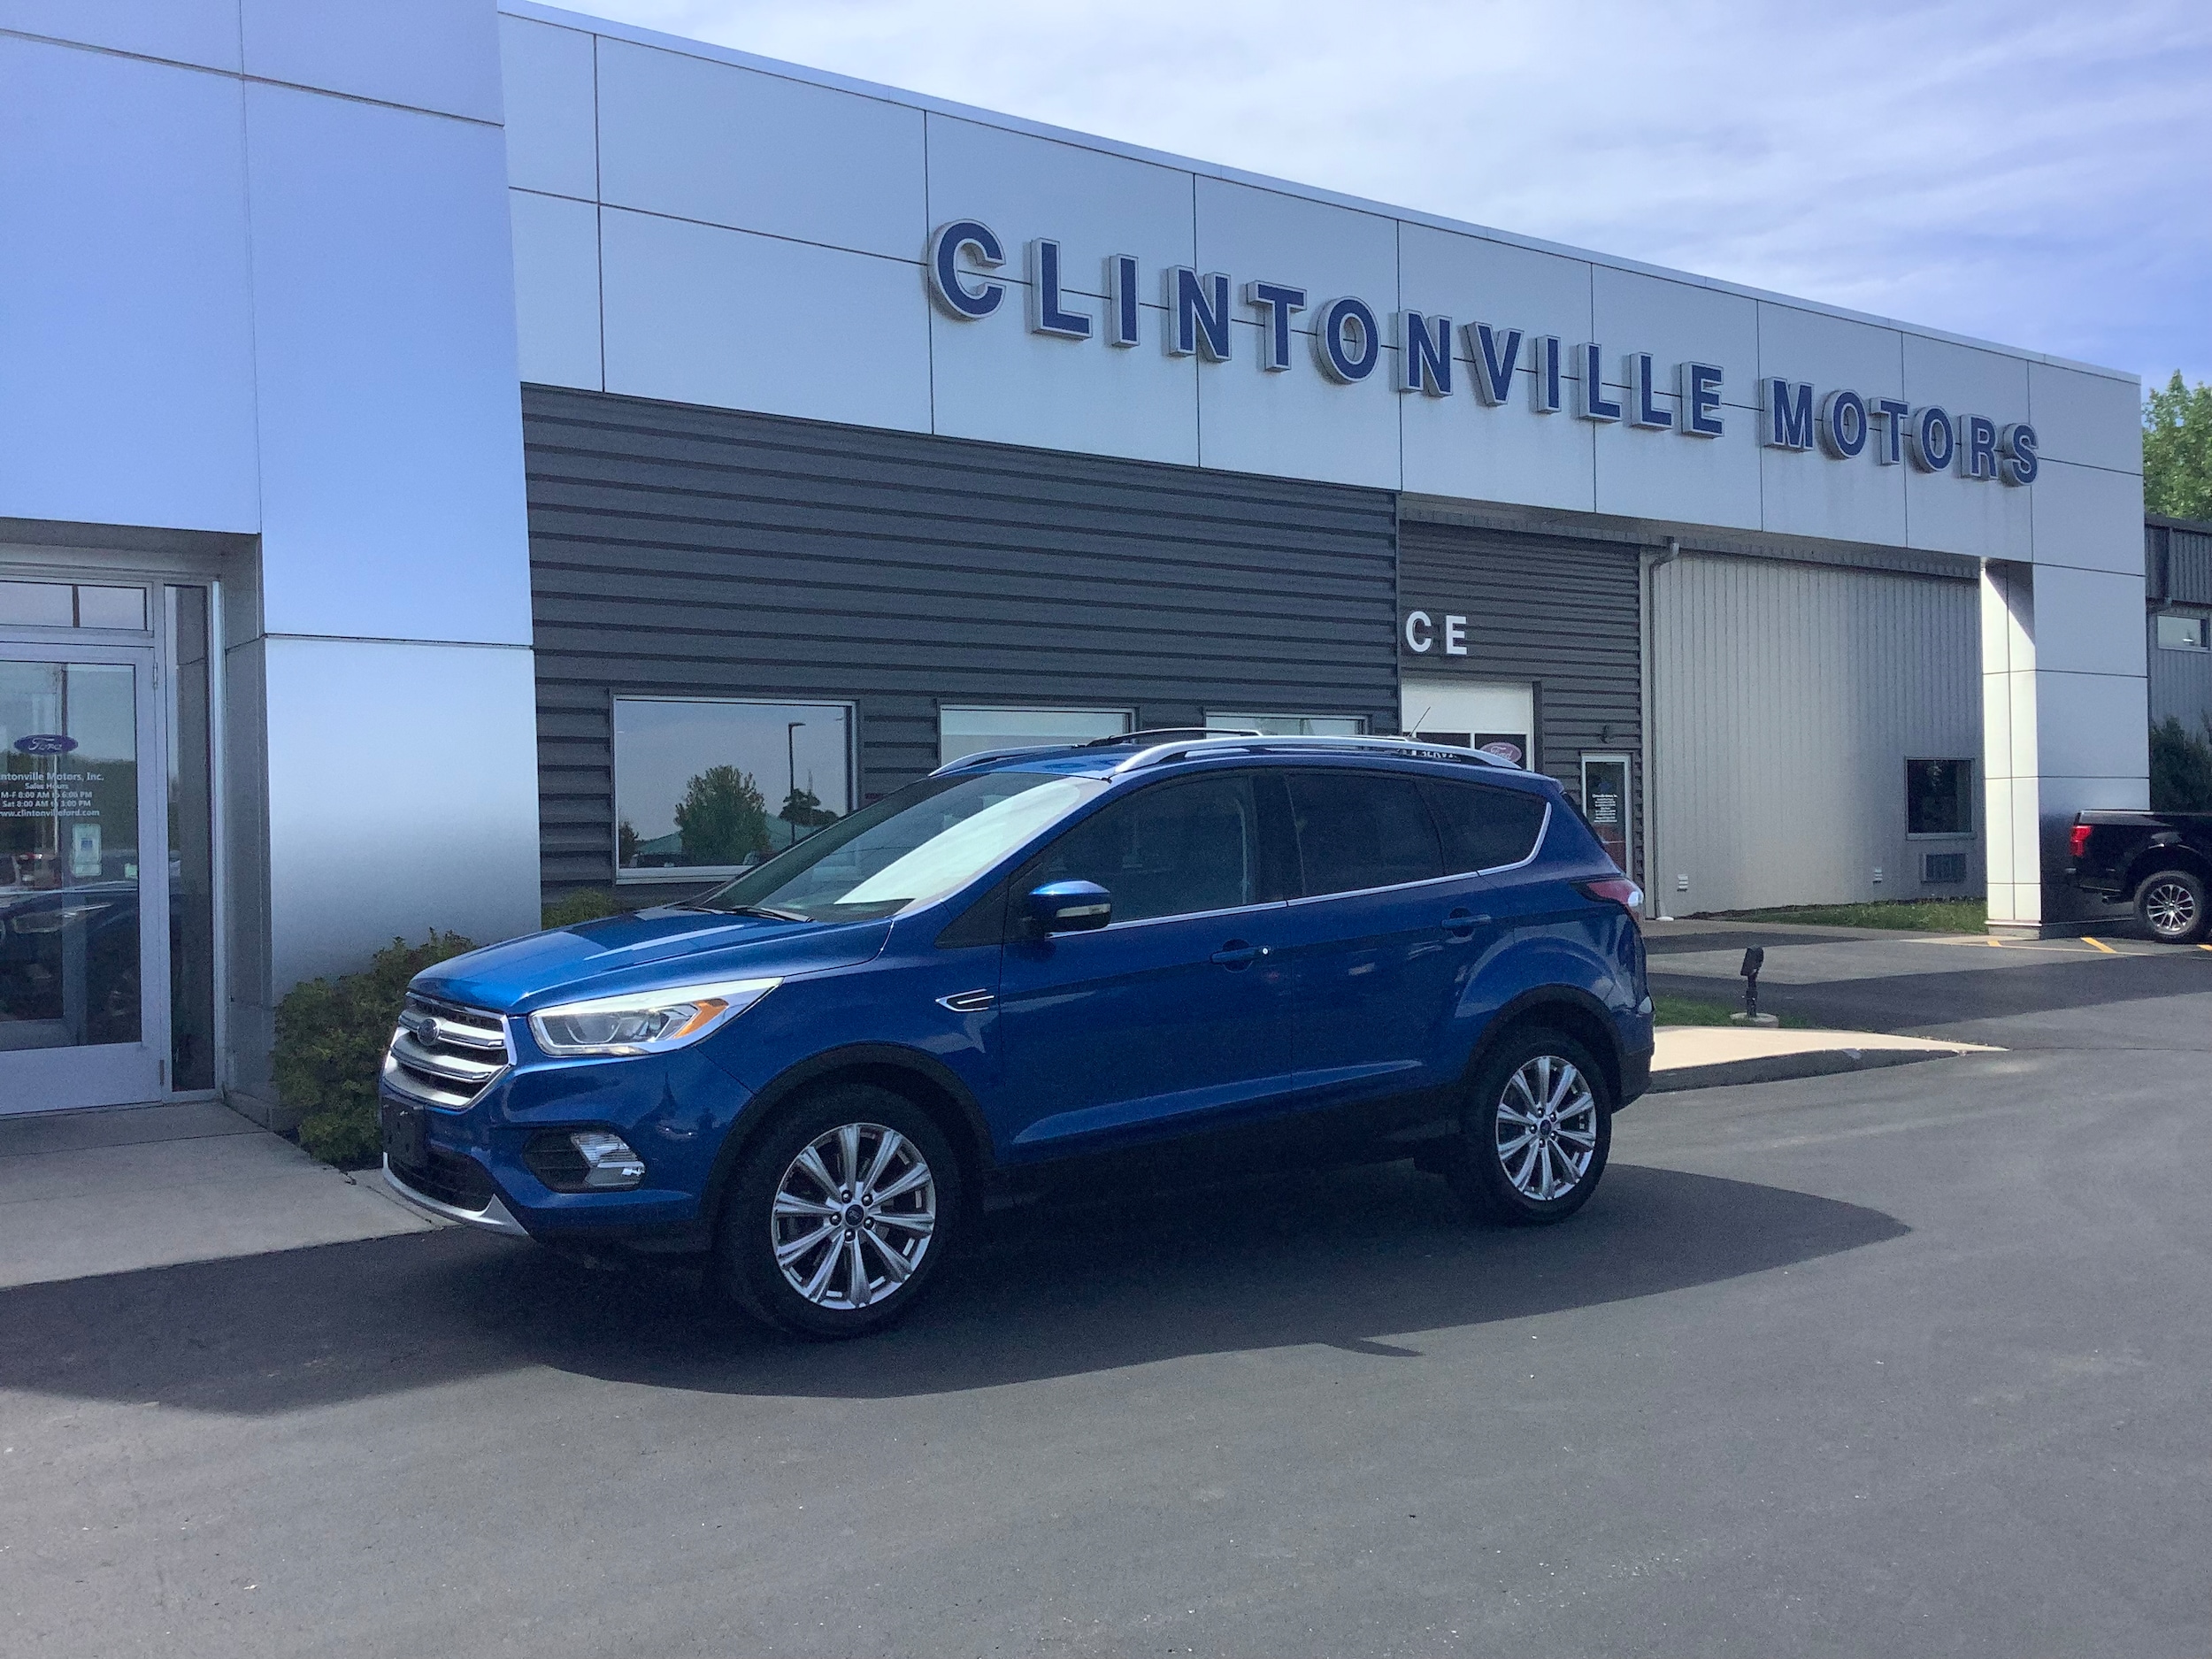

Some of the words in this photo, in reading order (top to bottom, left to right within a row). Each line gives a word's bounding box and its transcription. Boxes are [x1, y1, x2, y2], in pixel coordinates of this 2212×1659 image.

[929, 219, 1724, 439] CLINTONVILLE
[1763, 376, 2039, 488] MOTORS
[28, 737, 64, 751] Ford
[47, 772, 84, 782] Motors,
[87, 772, 104, 780] Inc.
